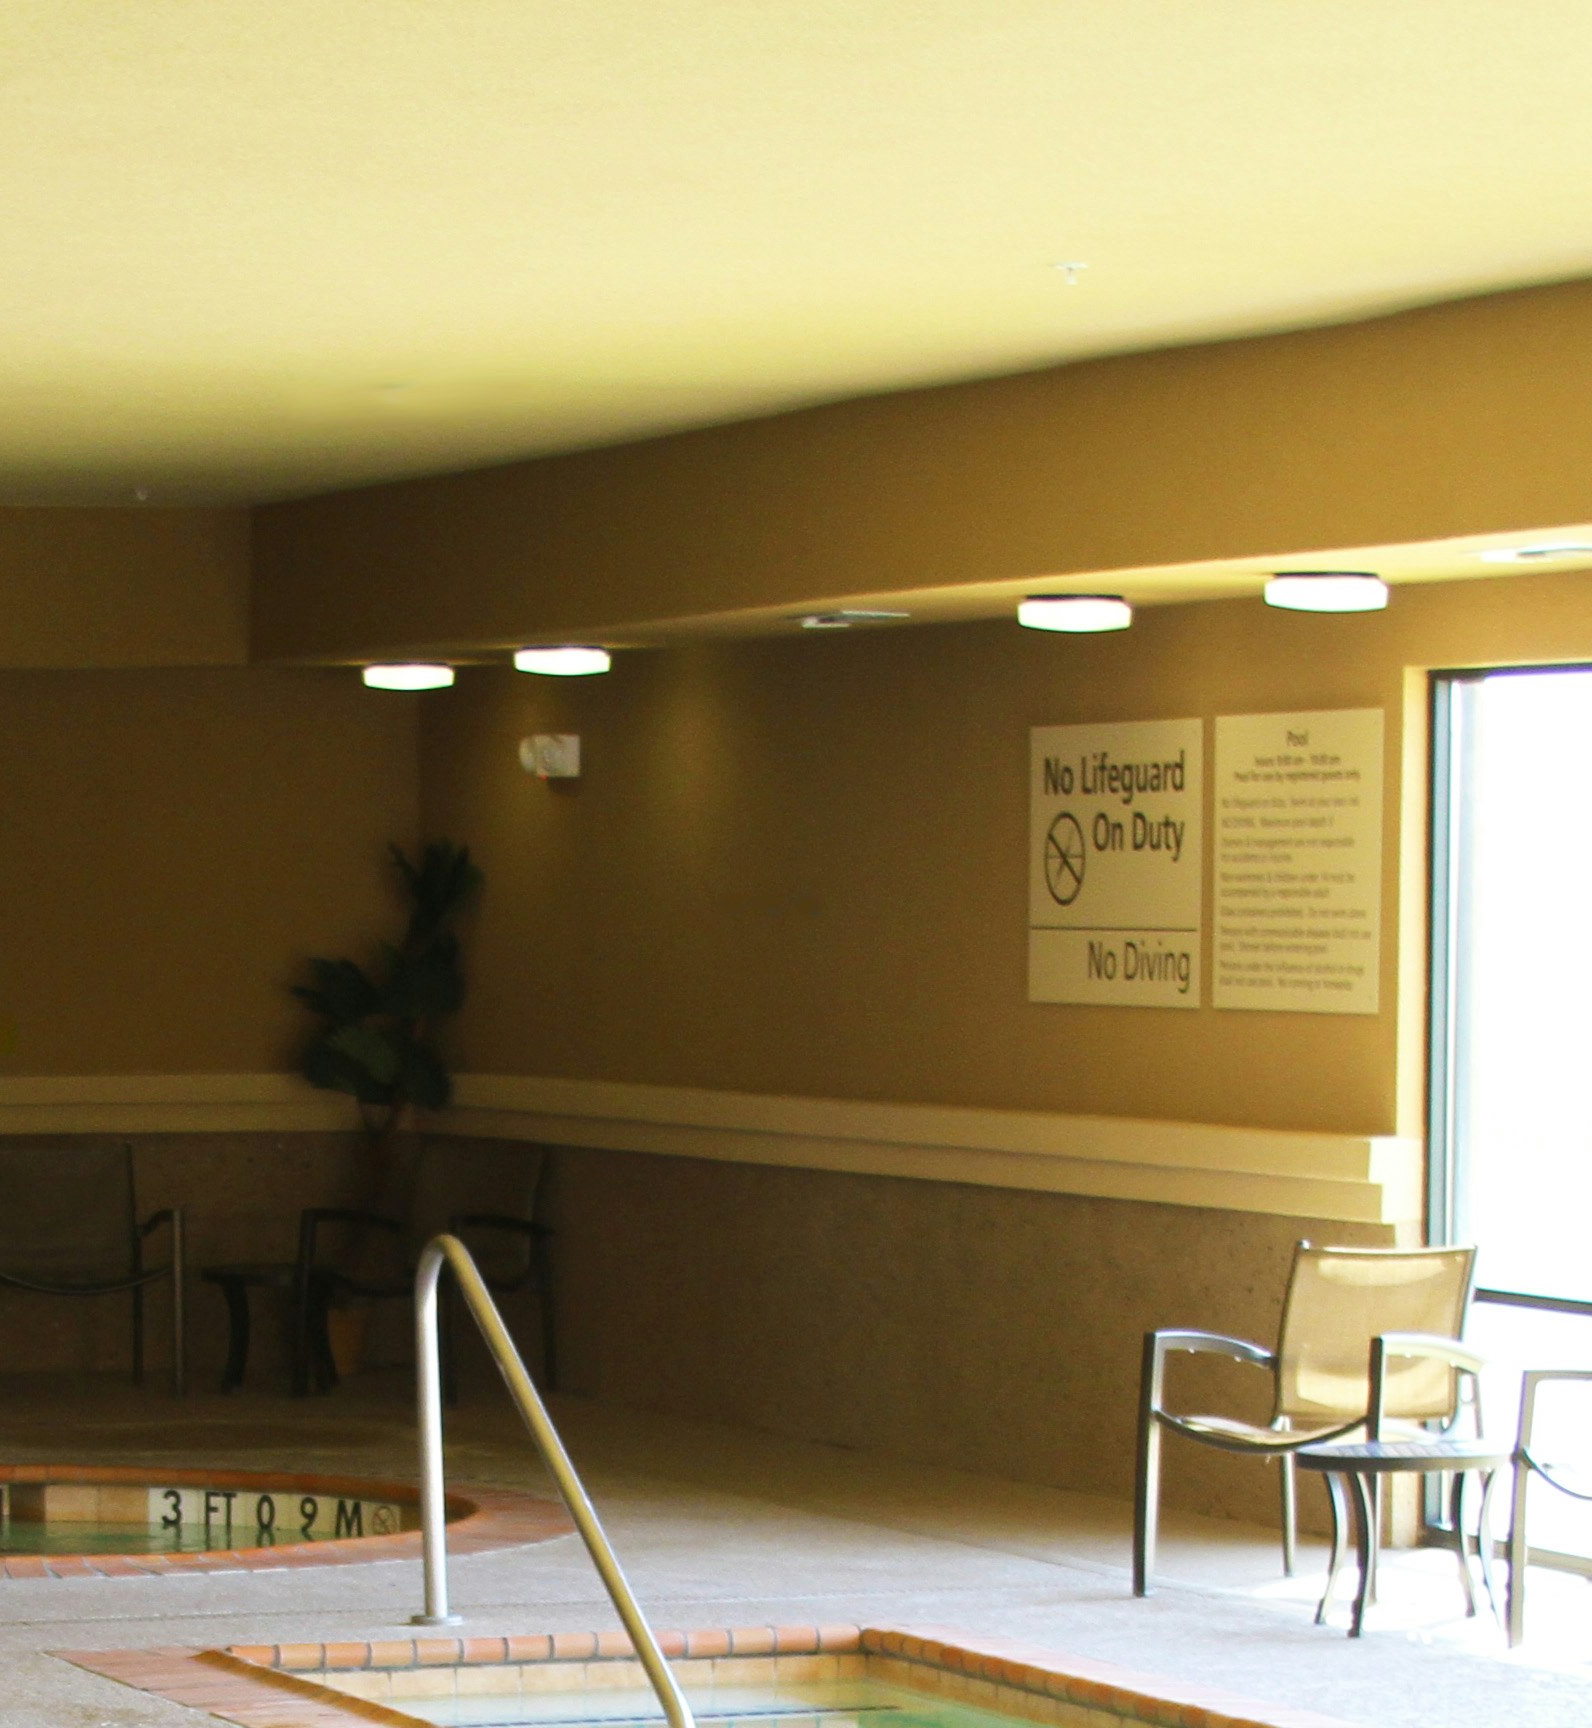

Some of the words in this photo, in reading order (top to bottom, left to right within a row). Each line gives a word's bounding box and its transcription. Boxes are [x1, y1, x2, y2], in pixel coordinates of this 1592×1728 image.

[1044, 757, 1075, 796] No
[1081, 748, 1185, 805] Lifeguard
[1092, 811, 1124, 852] On
[1132, 811, 1185, 862] Duty
[1088, 940, 1117, 981] No
[1123, 939, 1190, 994] Diving
[161, 1489, 182, 1526] 3
[205, 1491, 237, 1536] FT
[300, 1496, 318, 1536] 9
[335, 1499, 363, 1539] M
